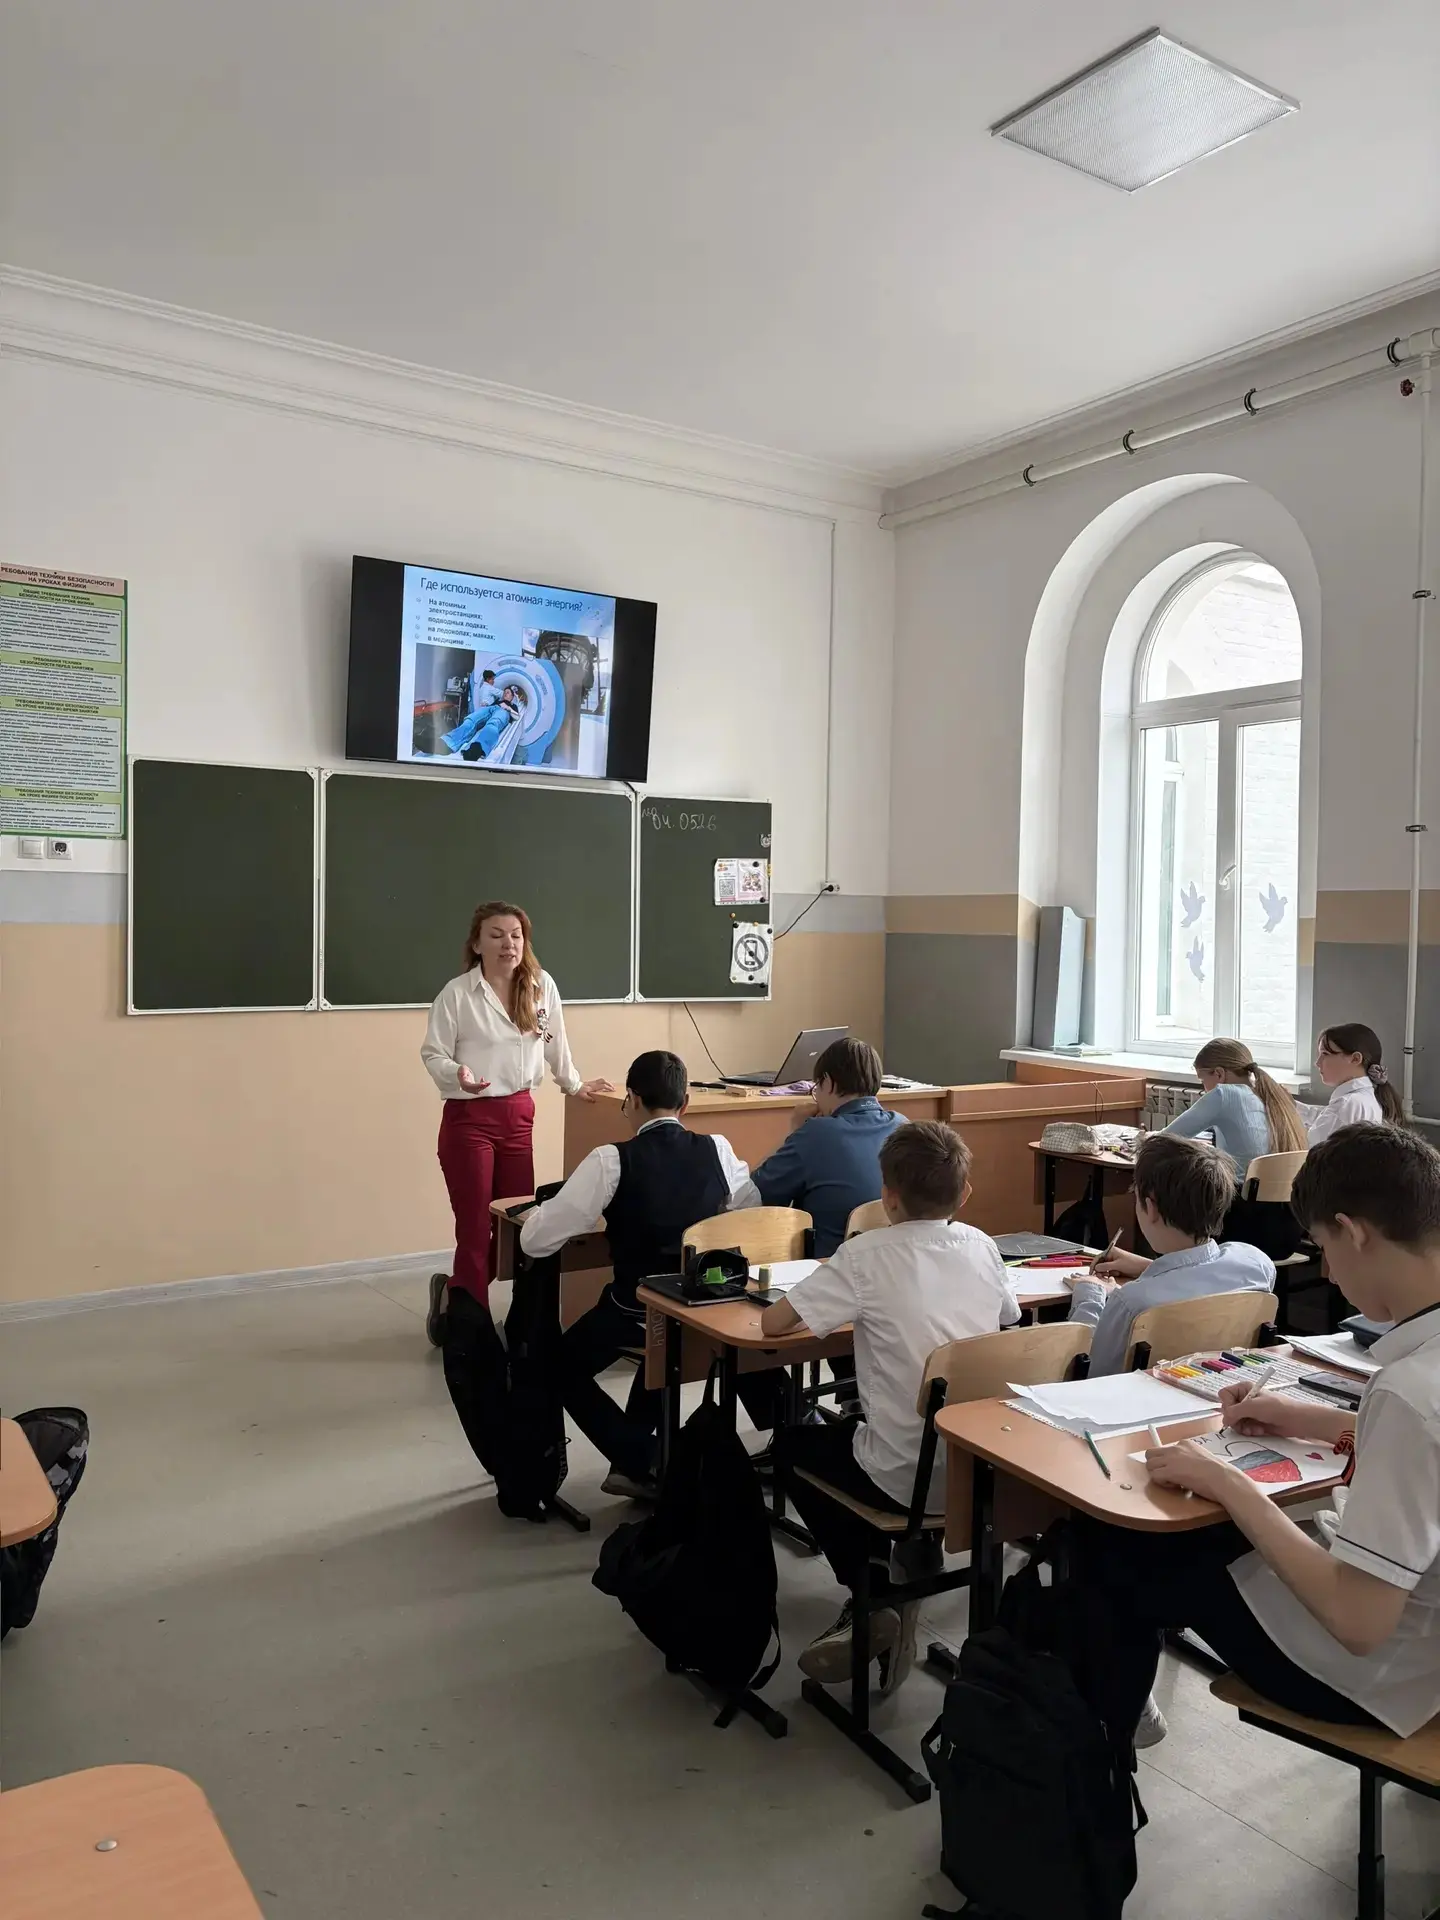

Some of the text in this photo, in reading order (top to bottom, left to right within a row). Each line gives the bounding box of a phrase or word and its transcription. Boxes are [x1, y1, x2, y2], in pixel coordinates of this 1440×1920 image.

[1, 566, 115, 587] РЕБОВАНИЯ ТЕХНИКИ БЕЗОПАСНОСТИ
[38, 578, 61, 586] УРОКАХ
[63, 581, 87, 589] ФИЗИКИ
[420, 577, 583, 612] Где используется атомная энергия?
[428, 598, 466, 610] На атомных
[428, 607, 483, 620] электростанциях;
[428, 616, 464, 627] подводных
[436, 627, 472, 638] ледоколах;
[433, 637, 464, 646] медицине
